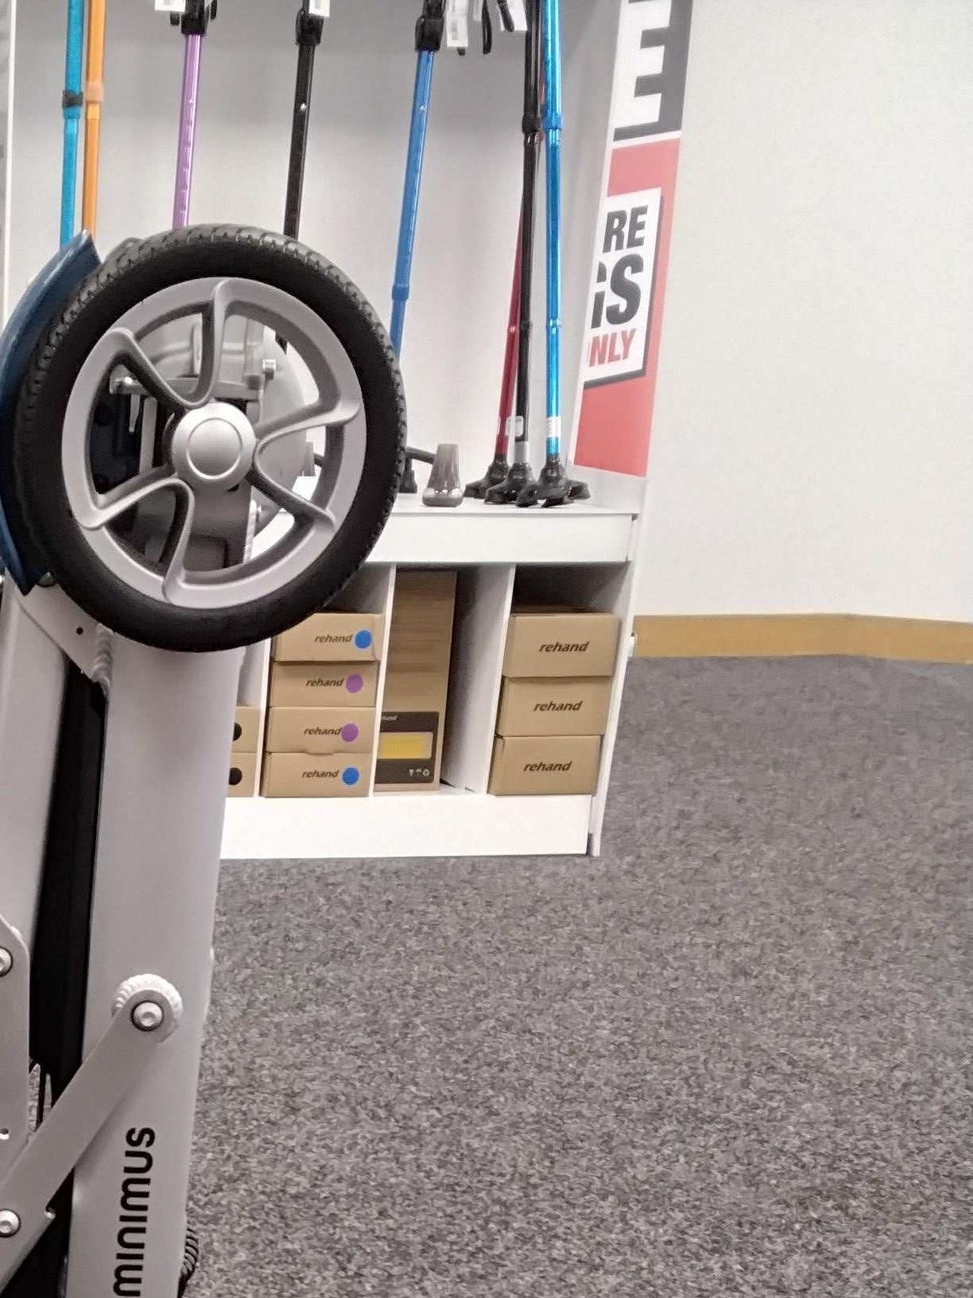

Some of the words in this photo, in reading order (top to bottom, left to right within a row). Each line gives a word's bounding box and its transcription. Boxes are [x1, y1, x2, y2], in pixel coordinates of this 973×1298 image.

[587, 328, 637, 367] NLY
[314, 634, 353, 643] rehand
[538, 641, 590, 653] rehand
[305, 678, 345, 687] rehand
[533, 700, 583, 712] rehand
[303, 727, 342, 736] rehand
[523, 761, 572, 772] rehand
[301, 770, 339, 779] rehand
[113, 1127, 156, 1297] minimus
